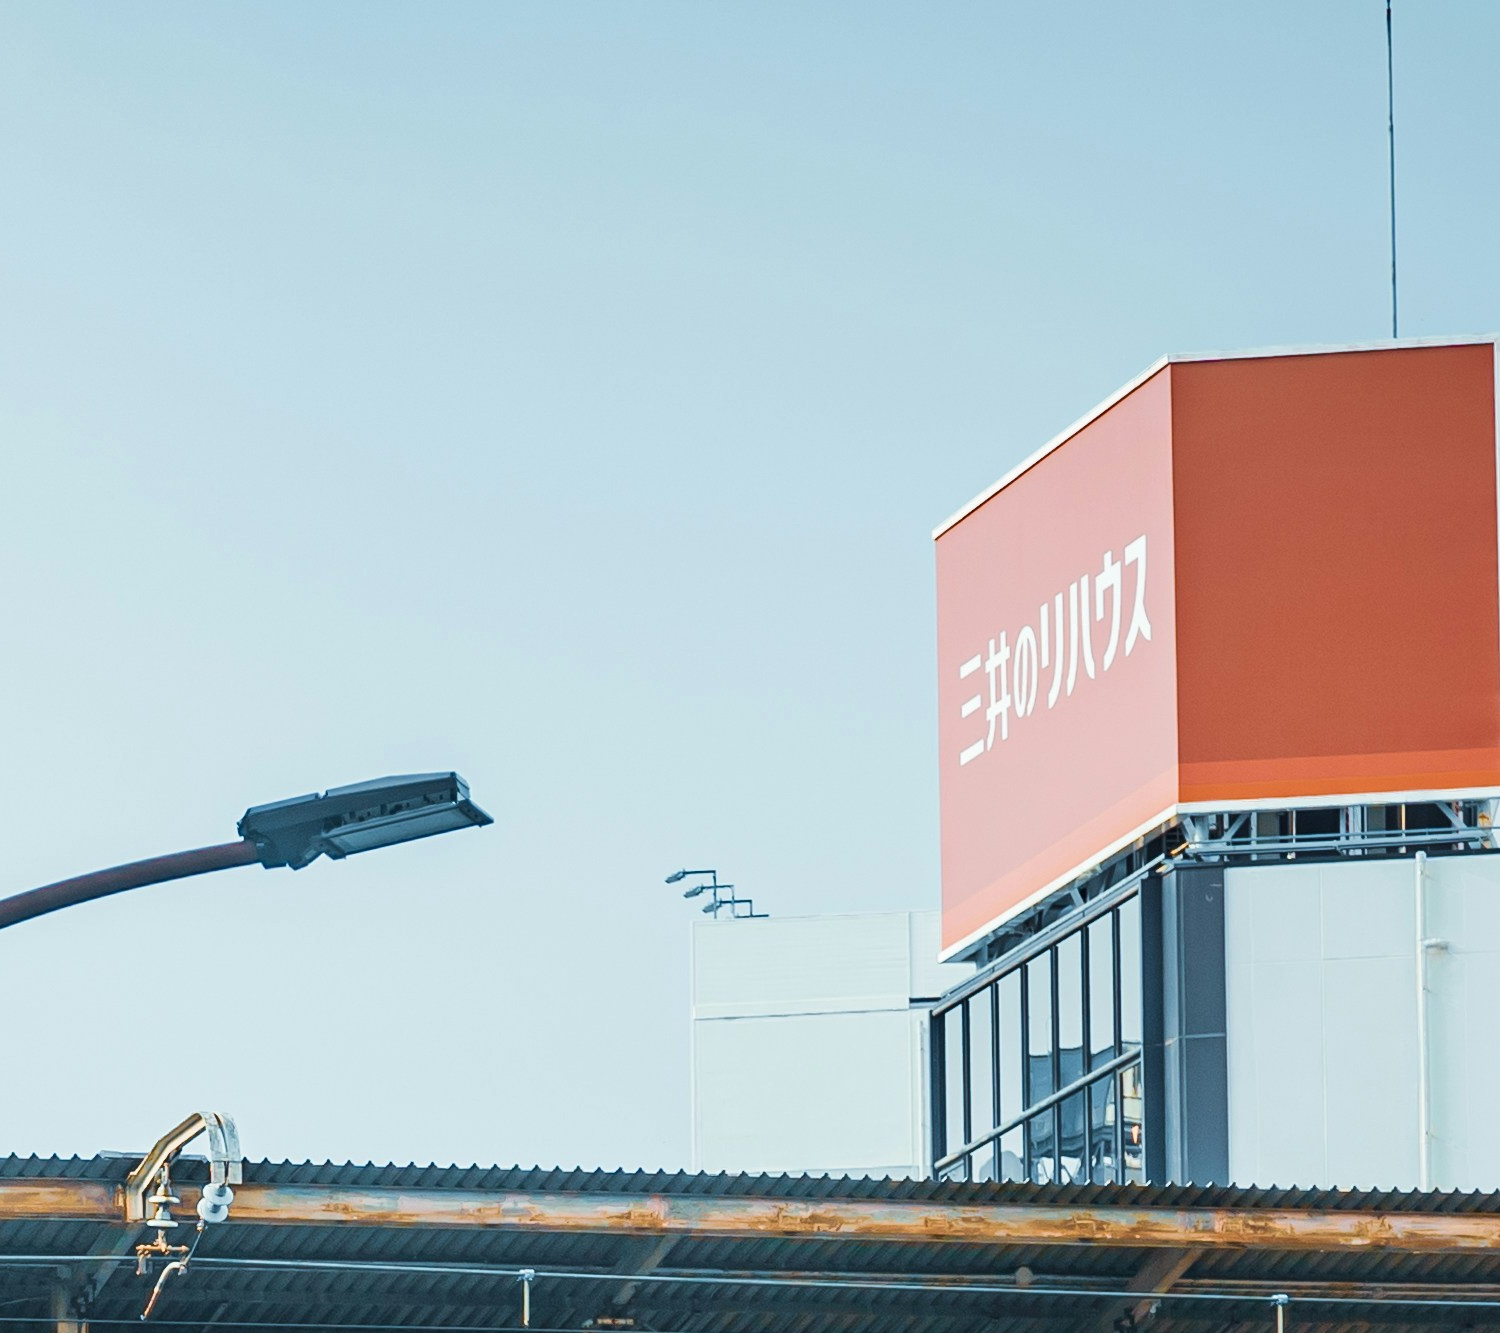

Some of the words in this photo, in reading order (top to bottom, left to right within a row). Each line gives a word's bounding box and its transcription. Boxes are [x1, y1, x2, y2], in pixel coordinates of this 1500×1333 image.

[959, 534, 1152, 767] 三井のリハウス
